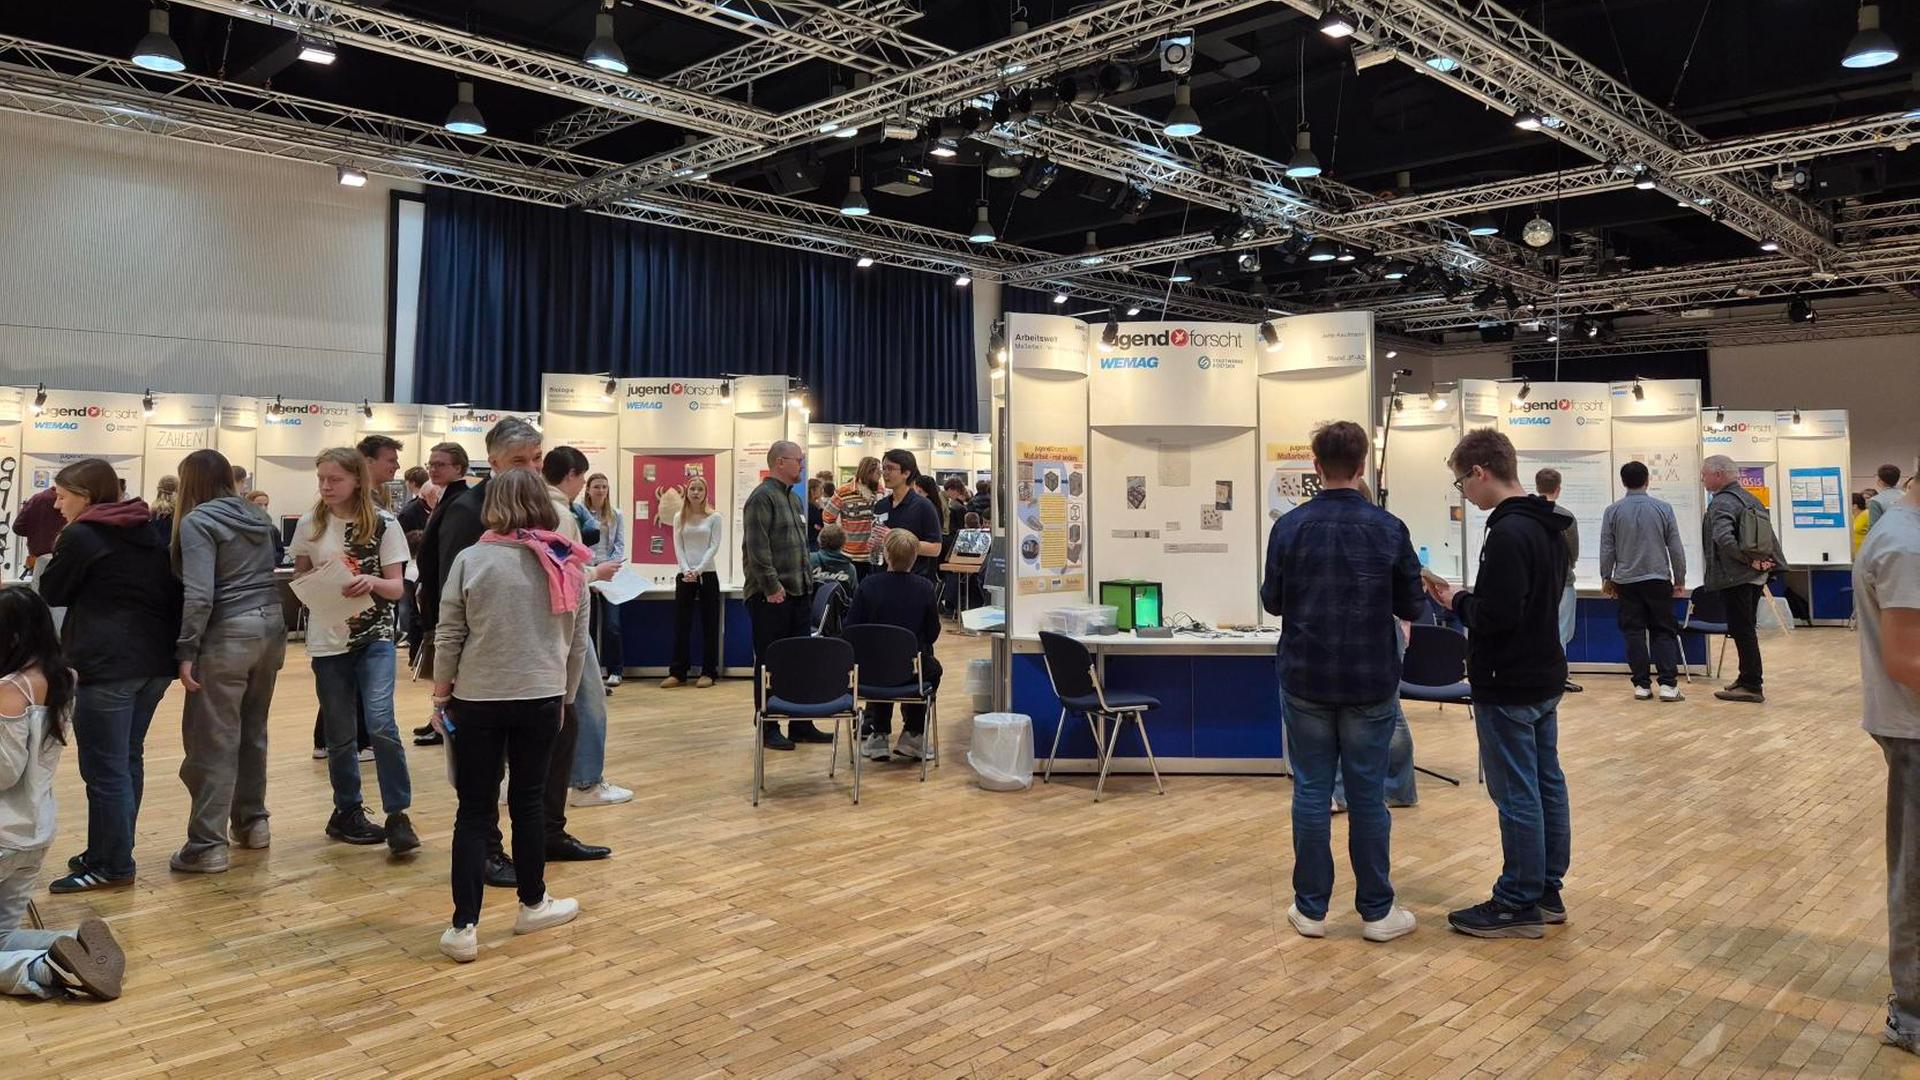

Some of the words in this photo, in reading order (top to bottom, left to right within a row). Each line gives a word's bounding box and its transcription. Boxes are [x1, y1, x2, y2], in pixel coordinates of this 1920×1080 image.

[1190, 329, 1243, 348] forscht
[1100, 356, 1160, 370] WEMAG
[626, 383, 670, 398] jugend
[684, 384, 721, 396] forsch
[626, 401, 663, 410] WEMAG
[34, 421, 79, 430] WEMAG
[1509, 416, 1552, 425] WEMAG
